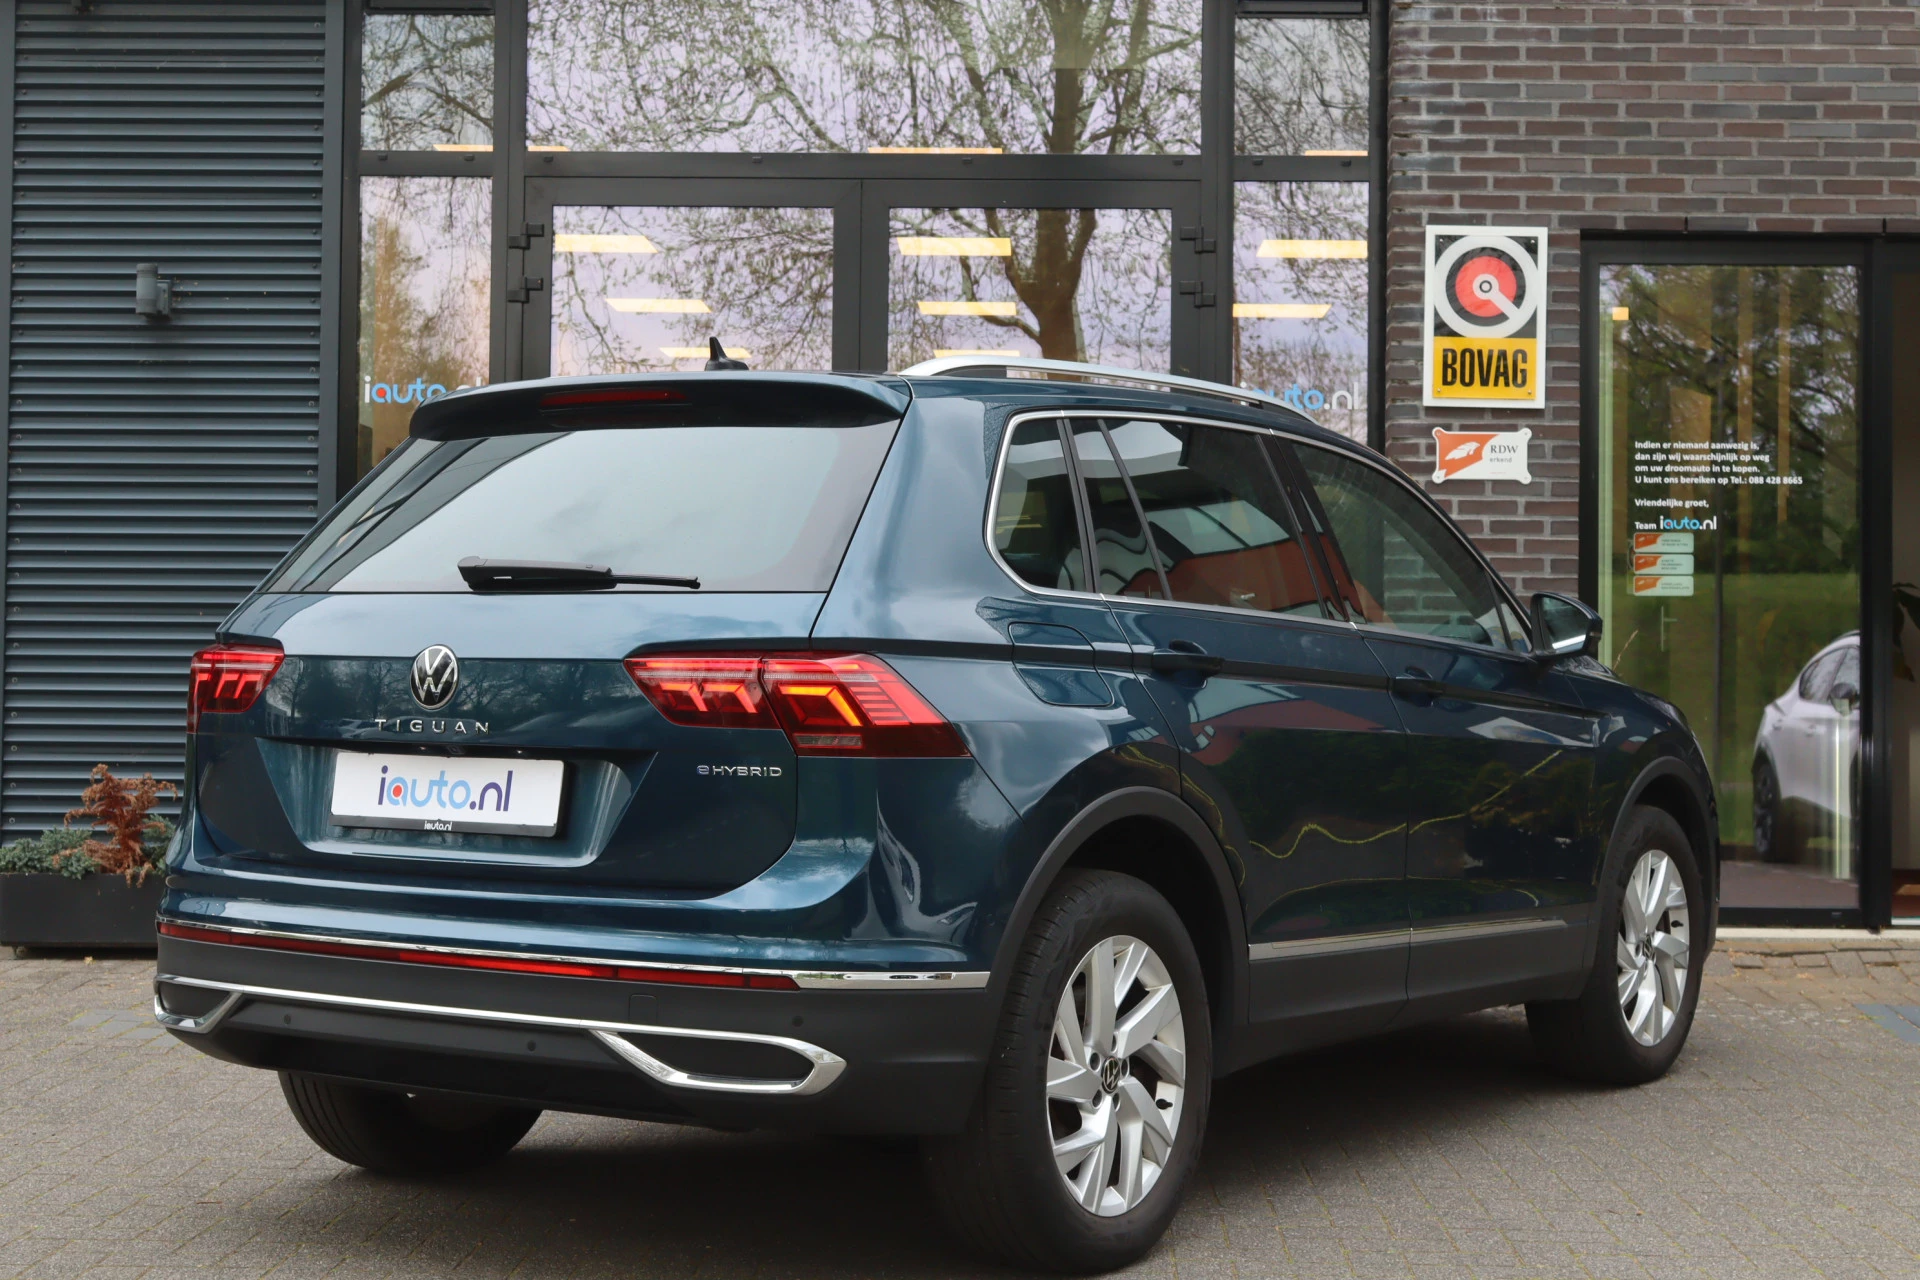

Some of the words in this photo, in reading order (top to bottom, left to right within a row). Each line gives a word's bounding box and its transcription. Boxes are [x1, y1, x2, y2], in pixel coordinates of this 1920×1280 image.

[1442, 348, 1528, 388] BOVAG
[364, 375, 482, 404] iauto
[1490, 444, 1518, 454] RDW
[1634, 440, 1661, 449] Indien
[1673, 441, 1709, 449] niemand
[1711, 441, 1749, 451] aanwezig
[1490, 456, 1513, 464] erkend
[1634, 452, 1651, 461] dan
[1652, 452, 1667, 463] zijn
[1668, 452, 1681, 463] wij
[1682, 452, 1739, 463] waarschijnlijk
[1740, 454, 1751, 463] op
[1752, 454, 1770, 463] weg
[1634, 464, 1649, 473] om
[1650, 465, 1664, 473] uw
[1664, 464, 1711, 473] droomauto
[1712, 464, 1721, 473] in
[1721, 465, 1731, 473] te
[1732, 464, 1761, 474] kopen.
[1634, 475, 1642, 484] U
[1643, 475, 1662, 484] kunt
[1680, 475, 1716, 484] bereiken
[1717, 477, 1729, 486] op
[1748, 476, 1765, 485] 088
[1765, 476, 1782, 485] 428
[1782, 476, 1803, 485] 8665
[1634, 498, 1684, 509] Vriendelijke
[1684, 499, 1710, 509] groet,
[1634, 521, 1657, 530] Team
[1660, 515, 1717, 530] iauto.nl
[375, 718, 491, 735] TIGUAN
[378, 765, 514, 813] iauto.nl
